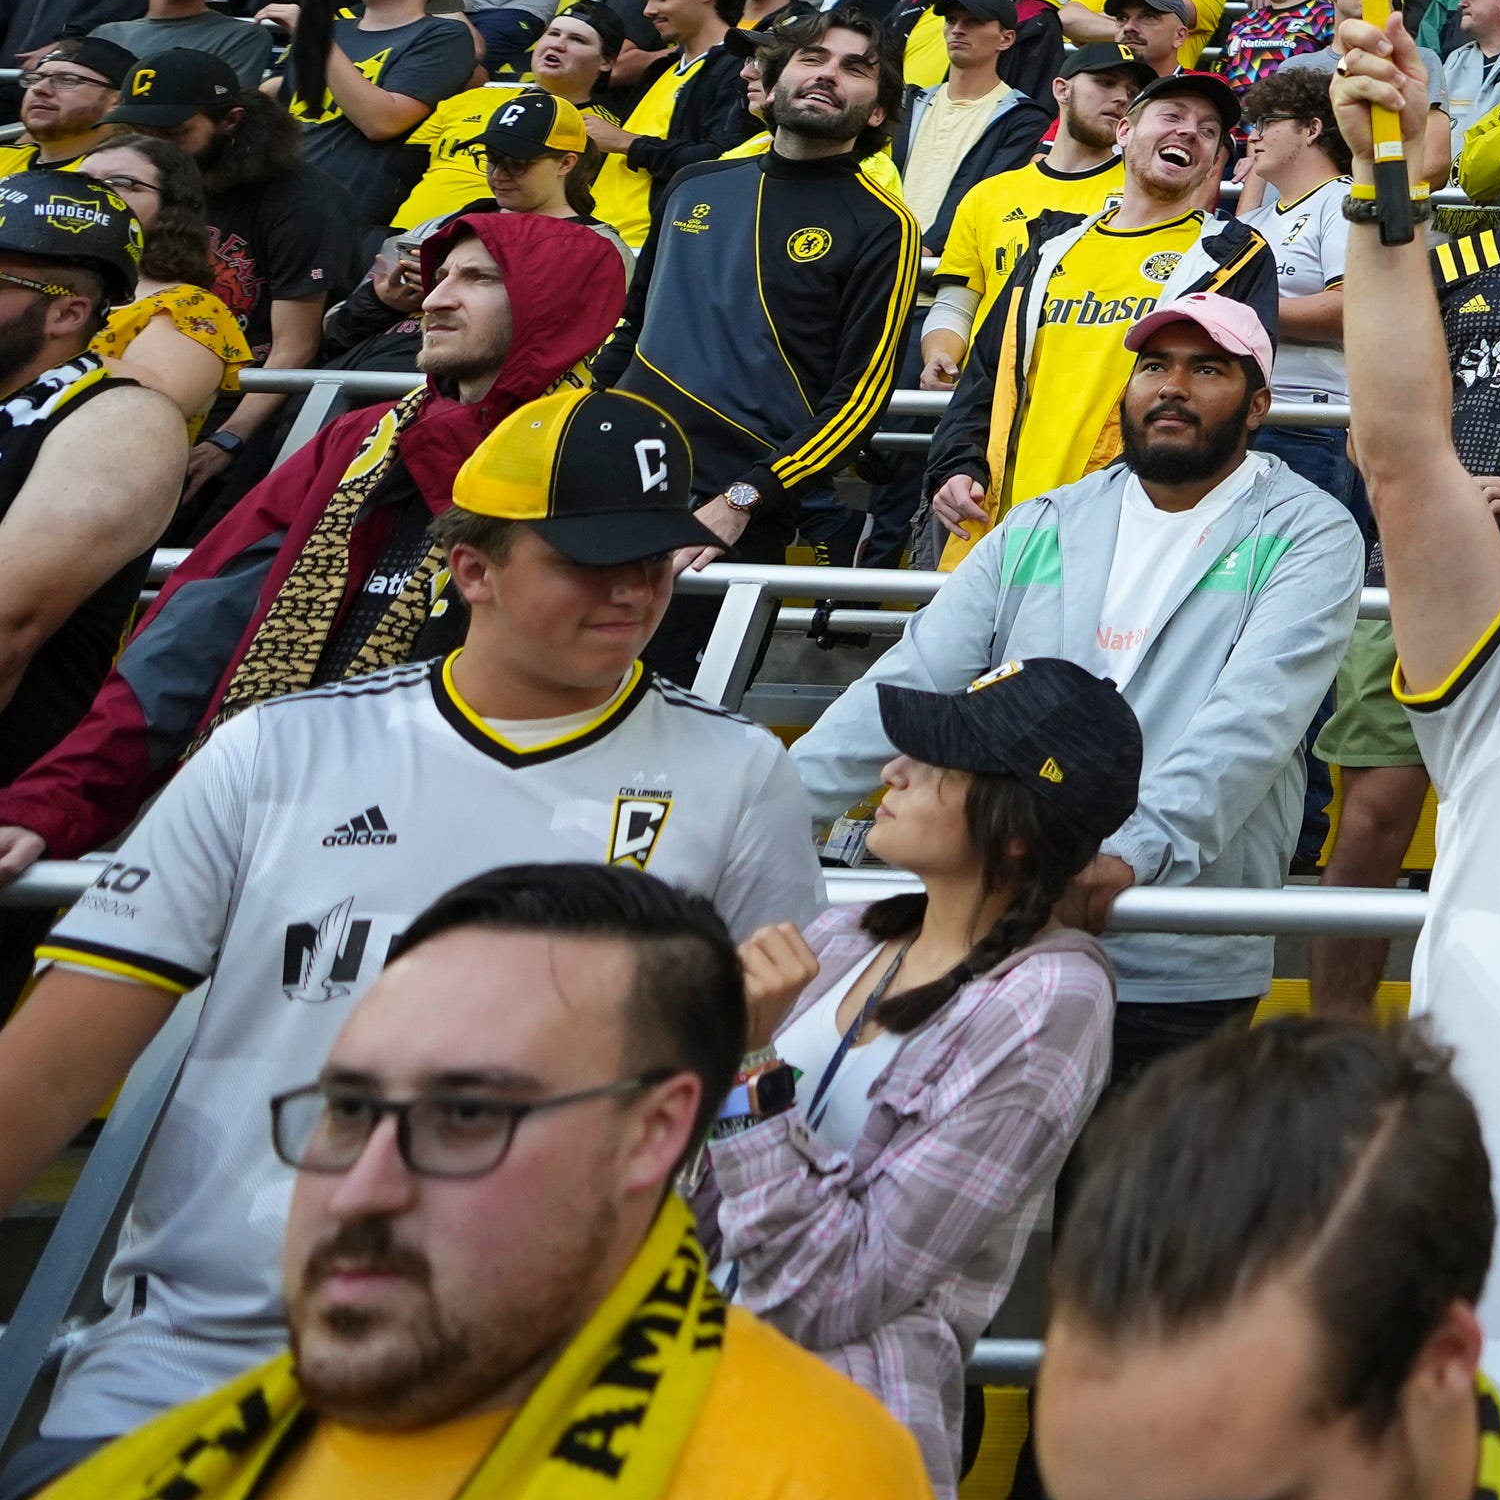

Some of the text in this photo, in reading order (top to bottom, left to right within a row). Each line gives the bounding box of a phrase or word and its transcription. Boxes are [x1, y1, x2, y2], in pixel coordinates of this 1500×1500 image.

[1240, 37, 1297, 50] Nationwide
[132, 68, 157, 97] C
[499, 104, 527, 126] C
[33, 202, 111, 227] NORDECKE
[1148, 252, 1184, 266] COLUMB
[1037, 290, 1158, 330] arbaso
[1458, 303, 1491, 315] adidas
[633, 438, 668, 493] C
[618, 786, 673, 799] COLUMBUS
[321, 831, 398, 848] adidas
[612, 800, 666, 860] C
